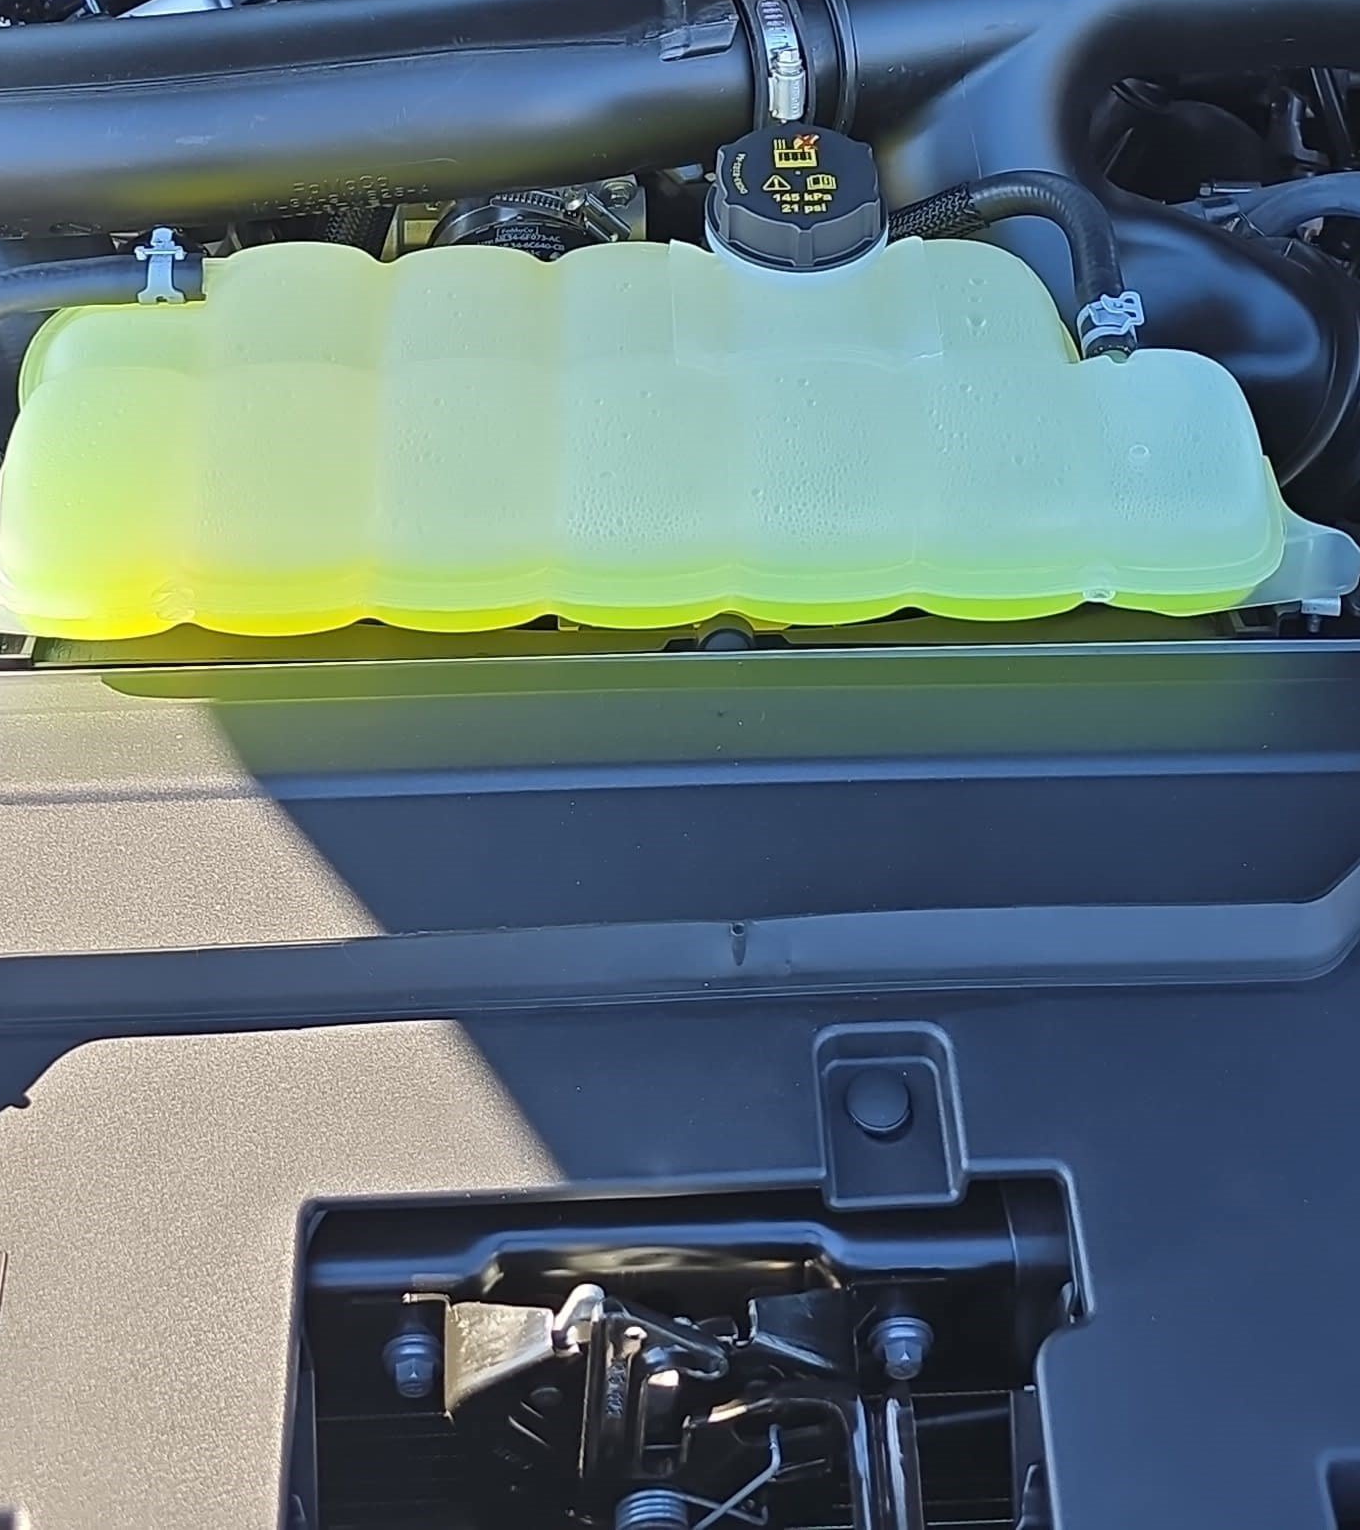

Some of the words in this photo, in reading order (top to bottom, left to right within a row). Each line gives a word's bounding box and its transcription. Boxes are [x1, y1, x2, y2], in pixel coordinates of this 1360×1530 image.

[772, 192, 801, 203] 145
[803, 192, 833, 202] kPa
[781, 203, 799, 213] 21
[803, 203, 827, 214] psi
